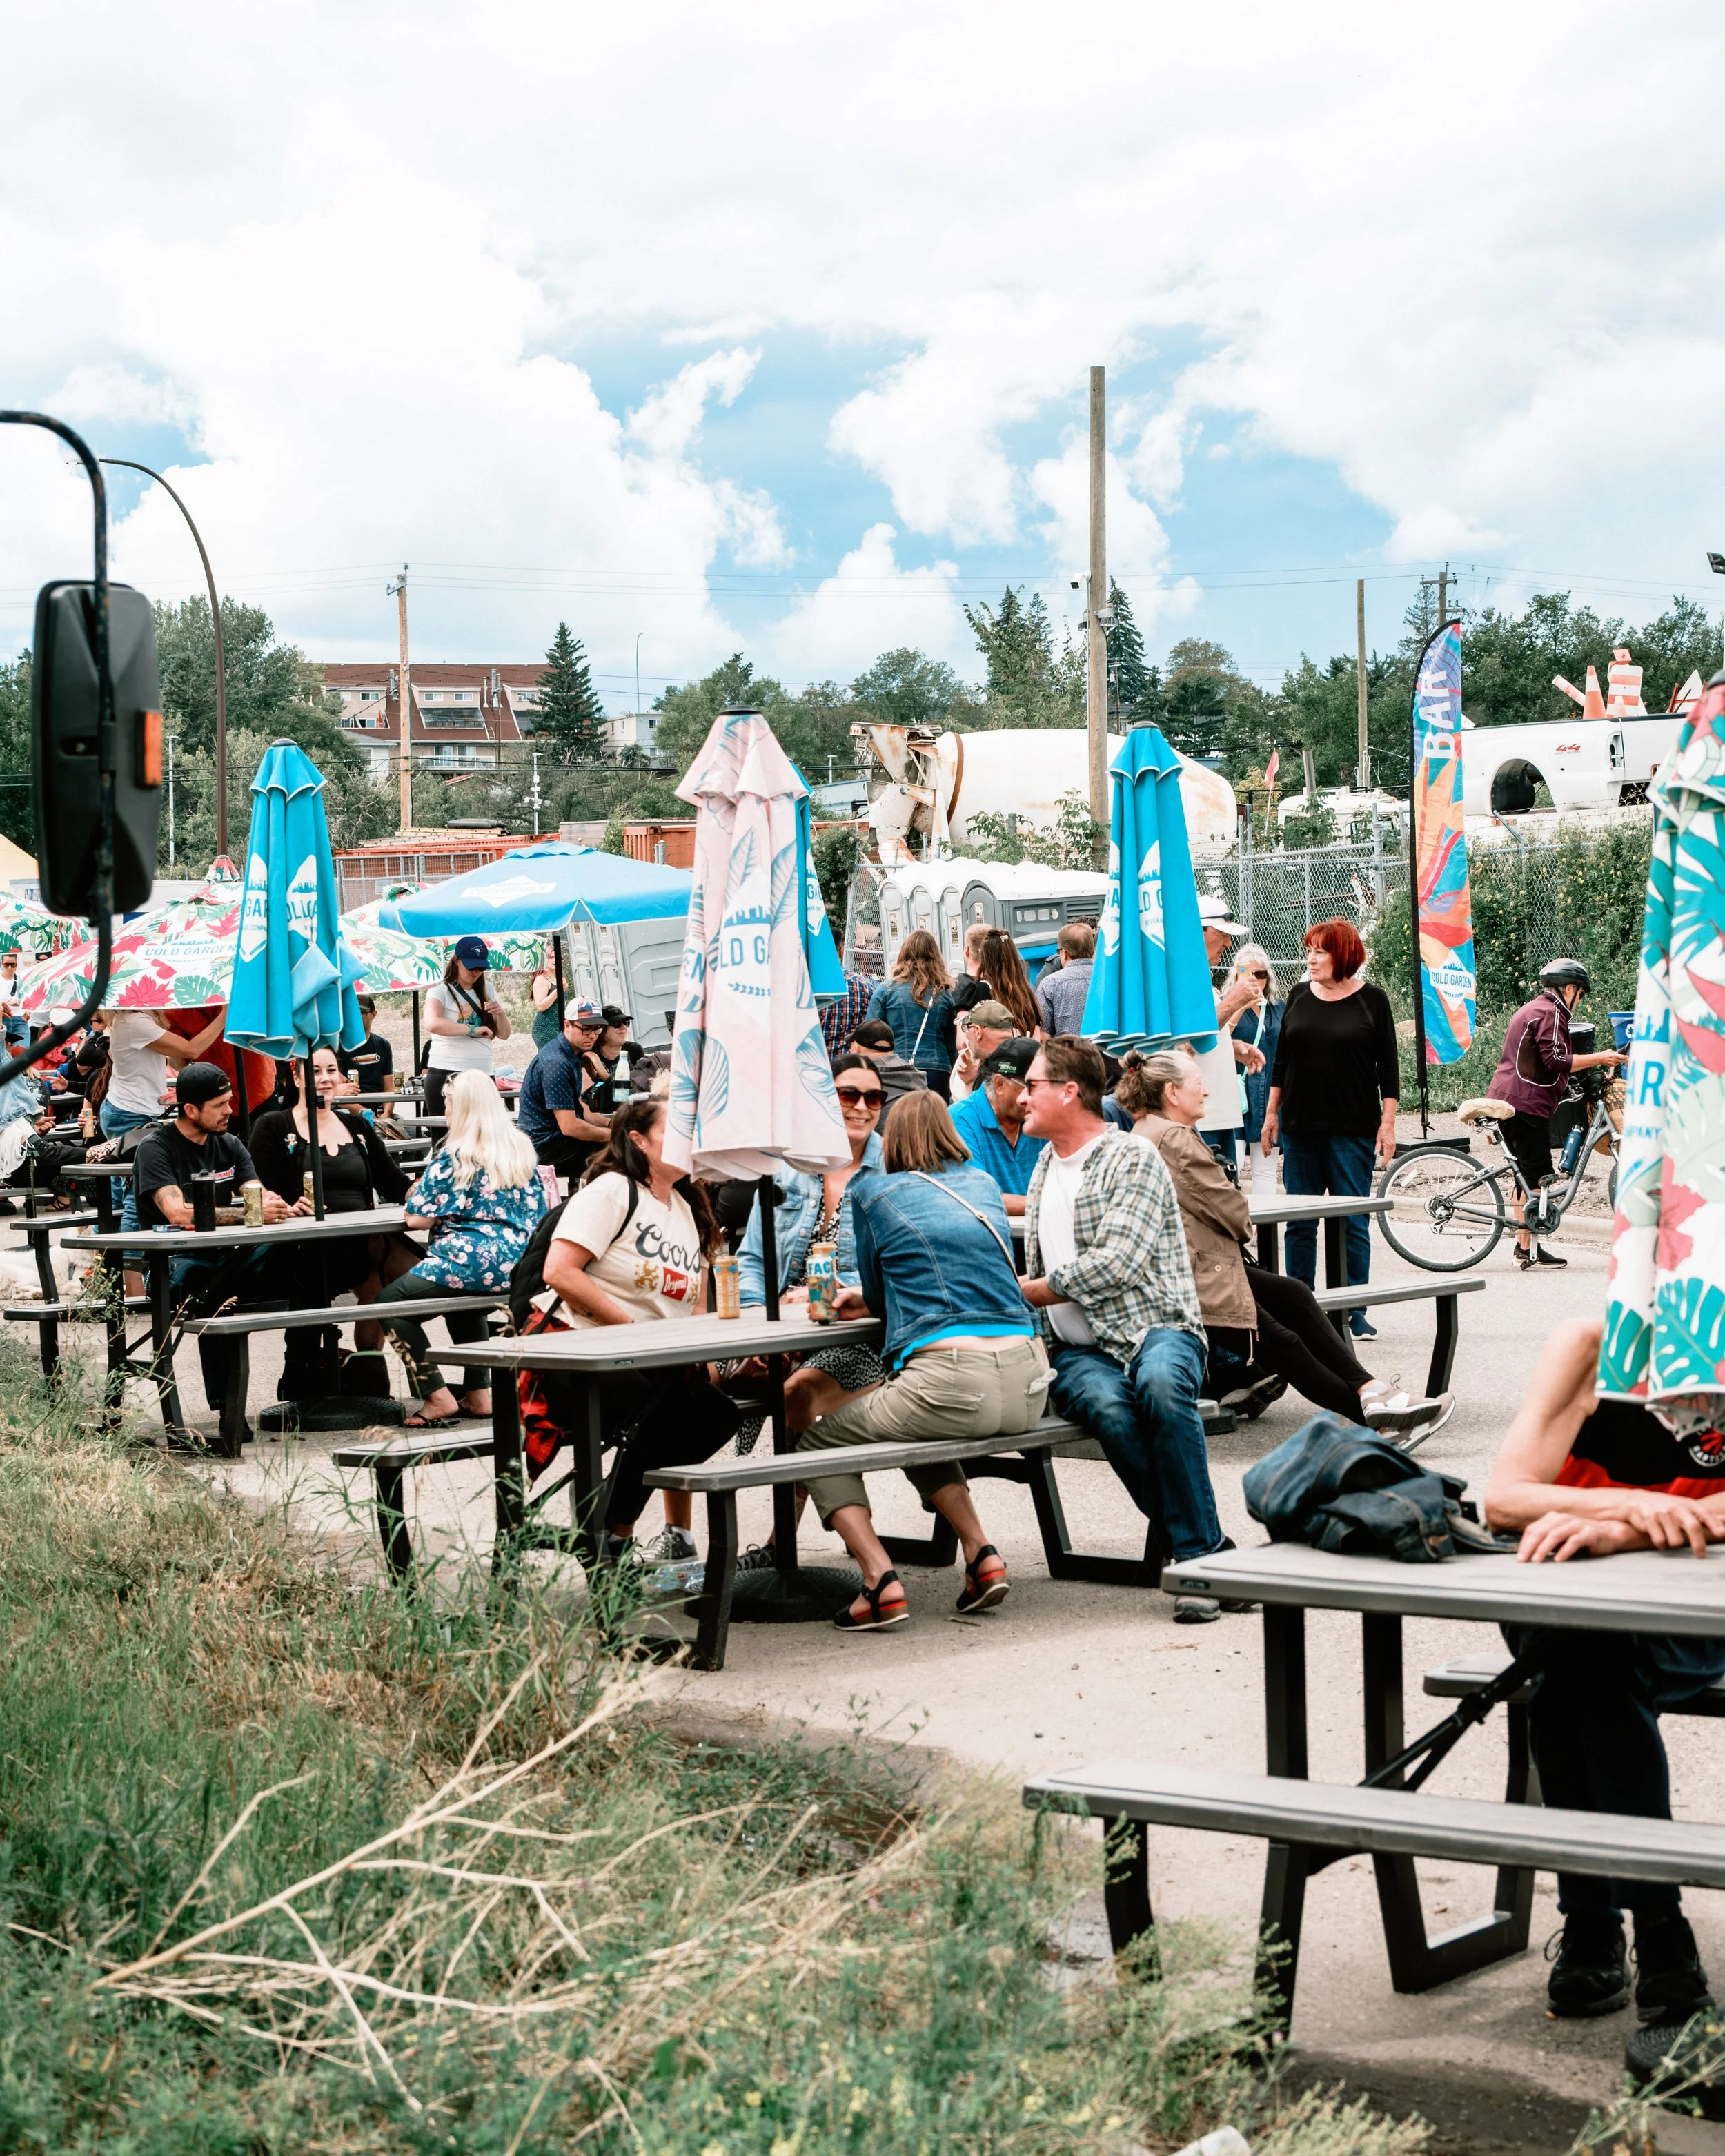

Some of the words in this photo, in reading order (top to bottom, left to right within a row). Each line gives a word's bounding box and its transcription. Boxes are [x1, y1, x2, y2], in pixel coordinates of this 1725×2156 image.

[1419, 670, 1455, 758] BAR
[145, 947, 179, 956] COLD
[184, 945, 237, 956] GARDEN
[1431, 971, 1449, 985] COLD
[1450, 974, 1472, 988] GARDEN
[635, 1222, 701, 1274] Coors
[664, 1274, 687, 1294] Original
